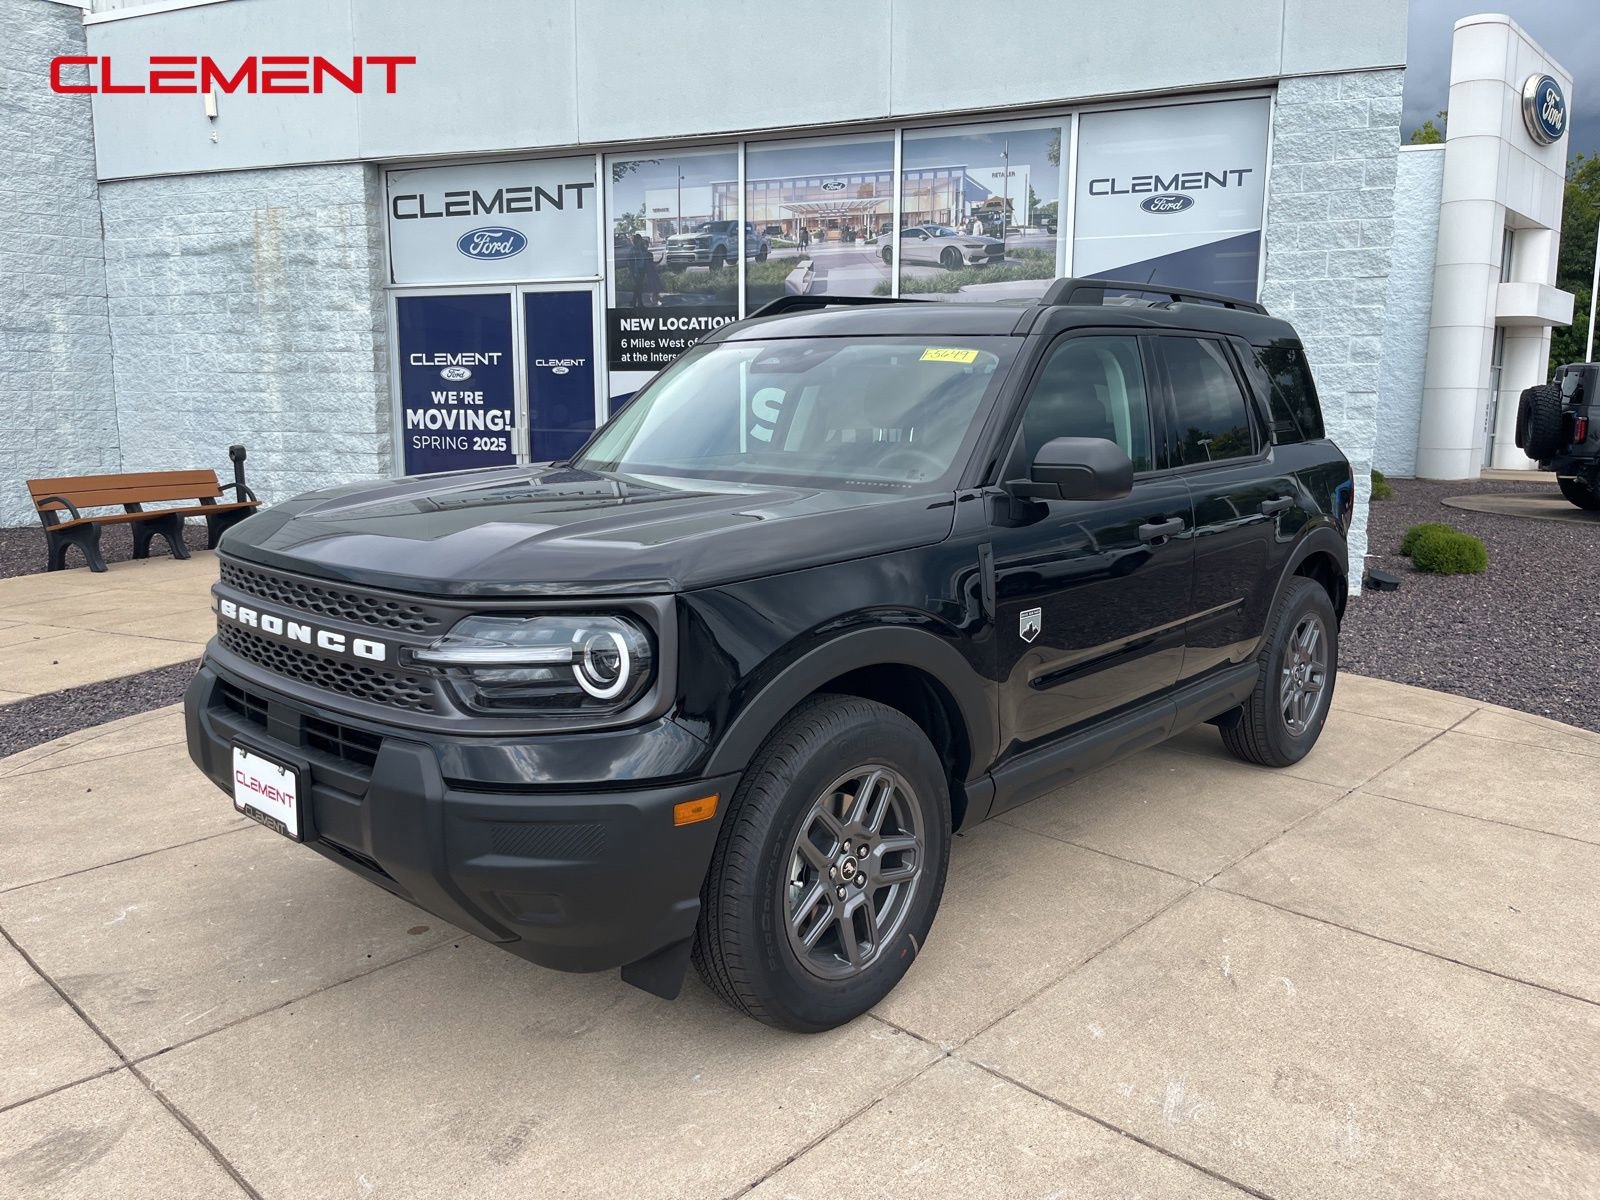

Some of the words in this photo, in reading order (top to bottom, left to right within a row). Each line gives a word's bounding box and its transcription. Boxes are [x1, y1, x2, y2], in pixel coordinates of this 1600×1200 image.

[1542, 87, 1564, 131] Ford
[1089, 168, 1253, 196] CLEMENT
[392, 182, 595, 220] CLEMENT
[1150, 196, 1184, 212] Ford
[469, 230, 514, 255] Ford
[620, 318, 655, 331] NEW
[620, 338, 628, 349] 6
[630, 338, 656, 349] Miles
[658, 337, 685, 348] West
[410, 352, 503, 366] CLEMENT
[535, 358, 586, 367] CLEMENT
[621, 352, 631, 362] at
[632, 351, 649, 362] the
[650, 351, 680, 362] Inters
[406, 408, 512, 431] MOVING!
[412, 435, 468, 450] SPRING
[473, 436, 507, 452] 2025
[220, 599, 386, 662] BRONCO
[235, 770, 295, 809] CLEMENT
[245, 805, 286, 835] CLEMENT
